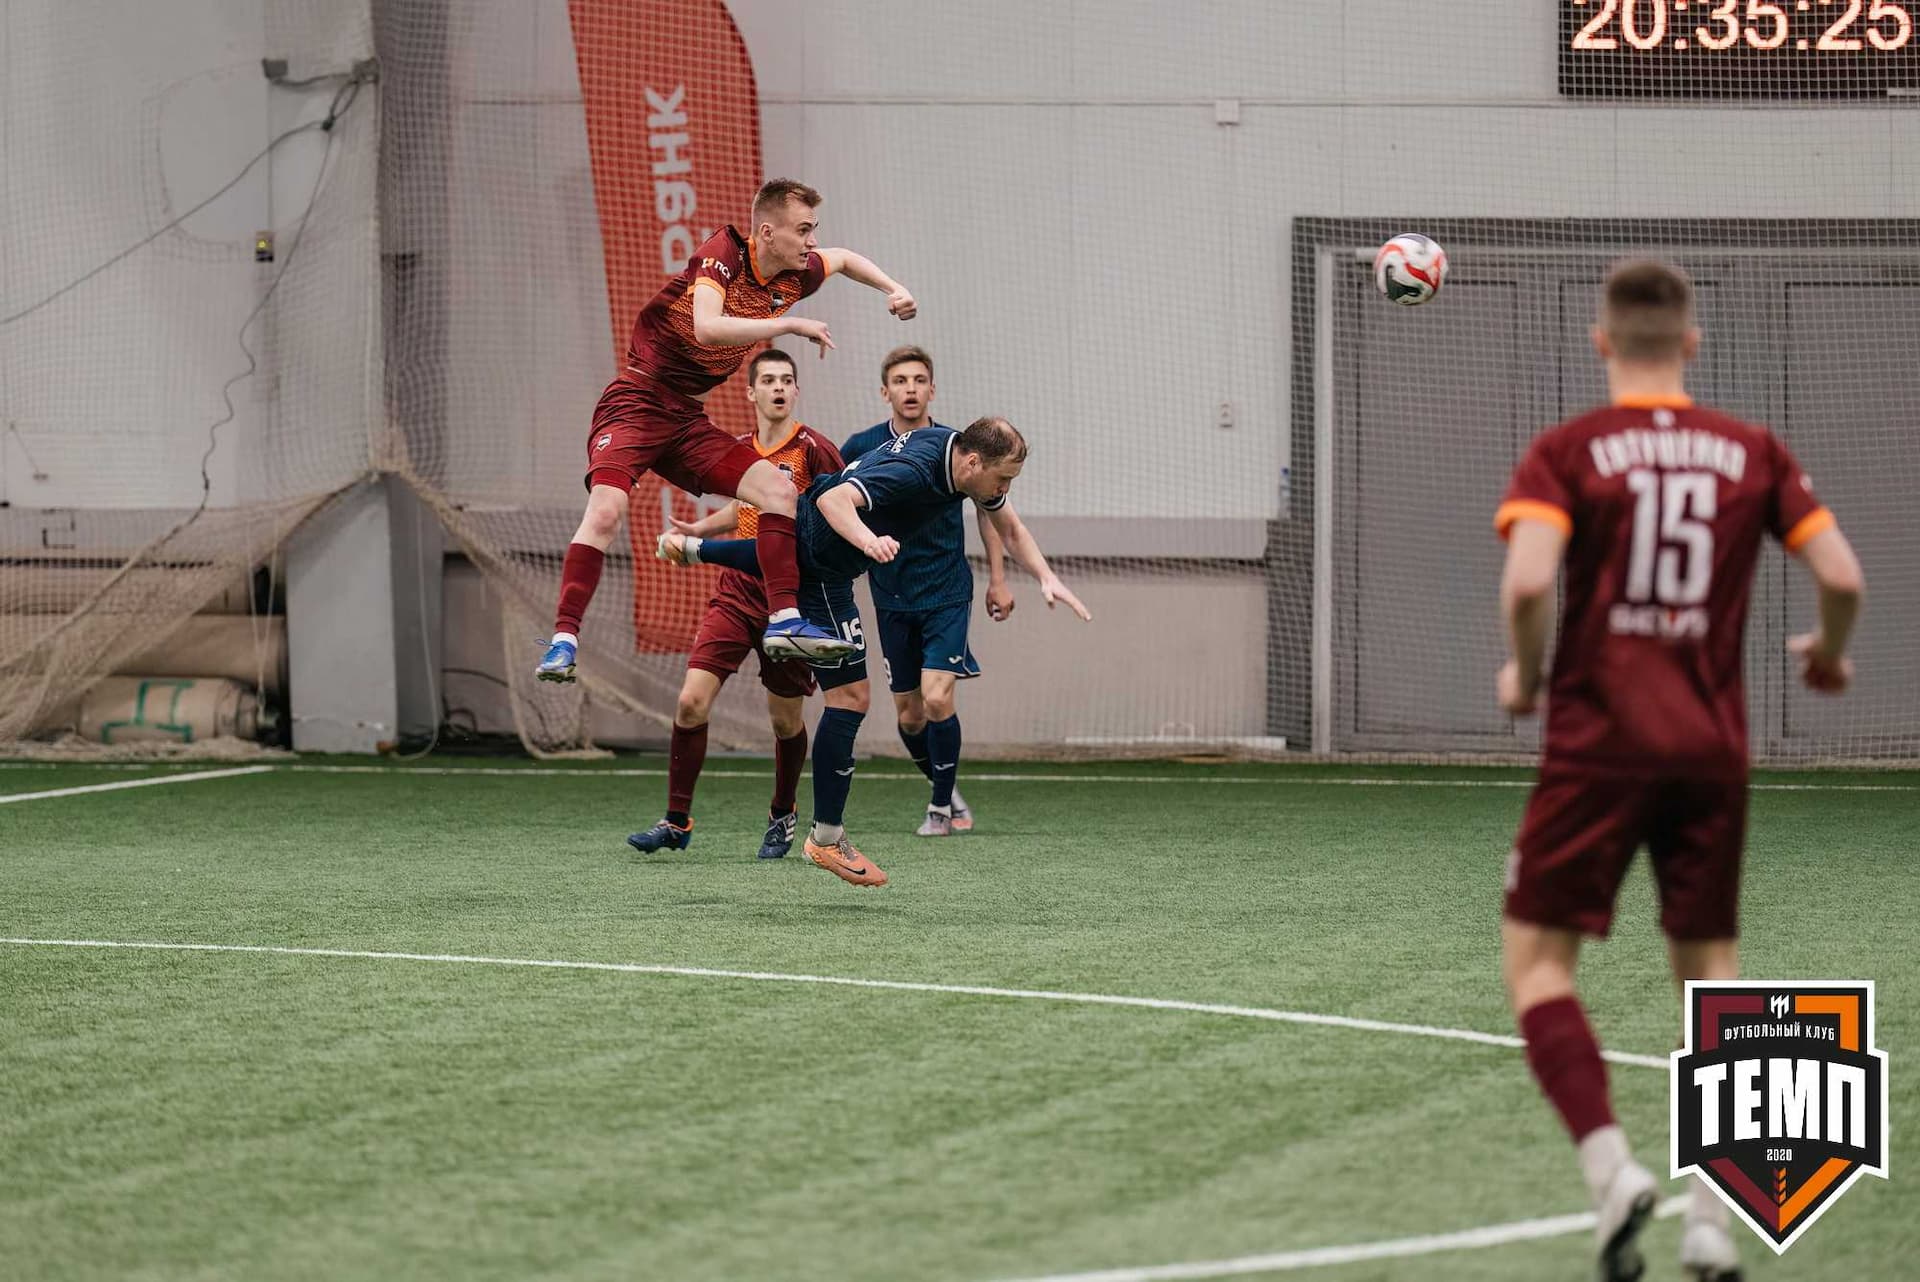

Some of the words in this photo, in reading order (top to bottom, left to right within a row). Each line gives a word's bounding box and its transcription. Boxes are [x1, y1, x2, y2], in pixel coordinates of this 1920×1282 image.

[1571, 0, 1912, 50] 20:35:25
[1626, 470, 1717, 604] 15
[842, 617, 865, 651] 15
